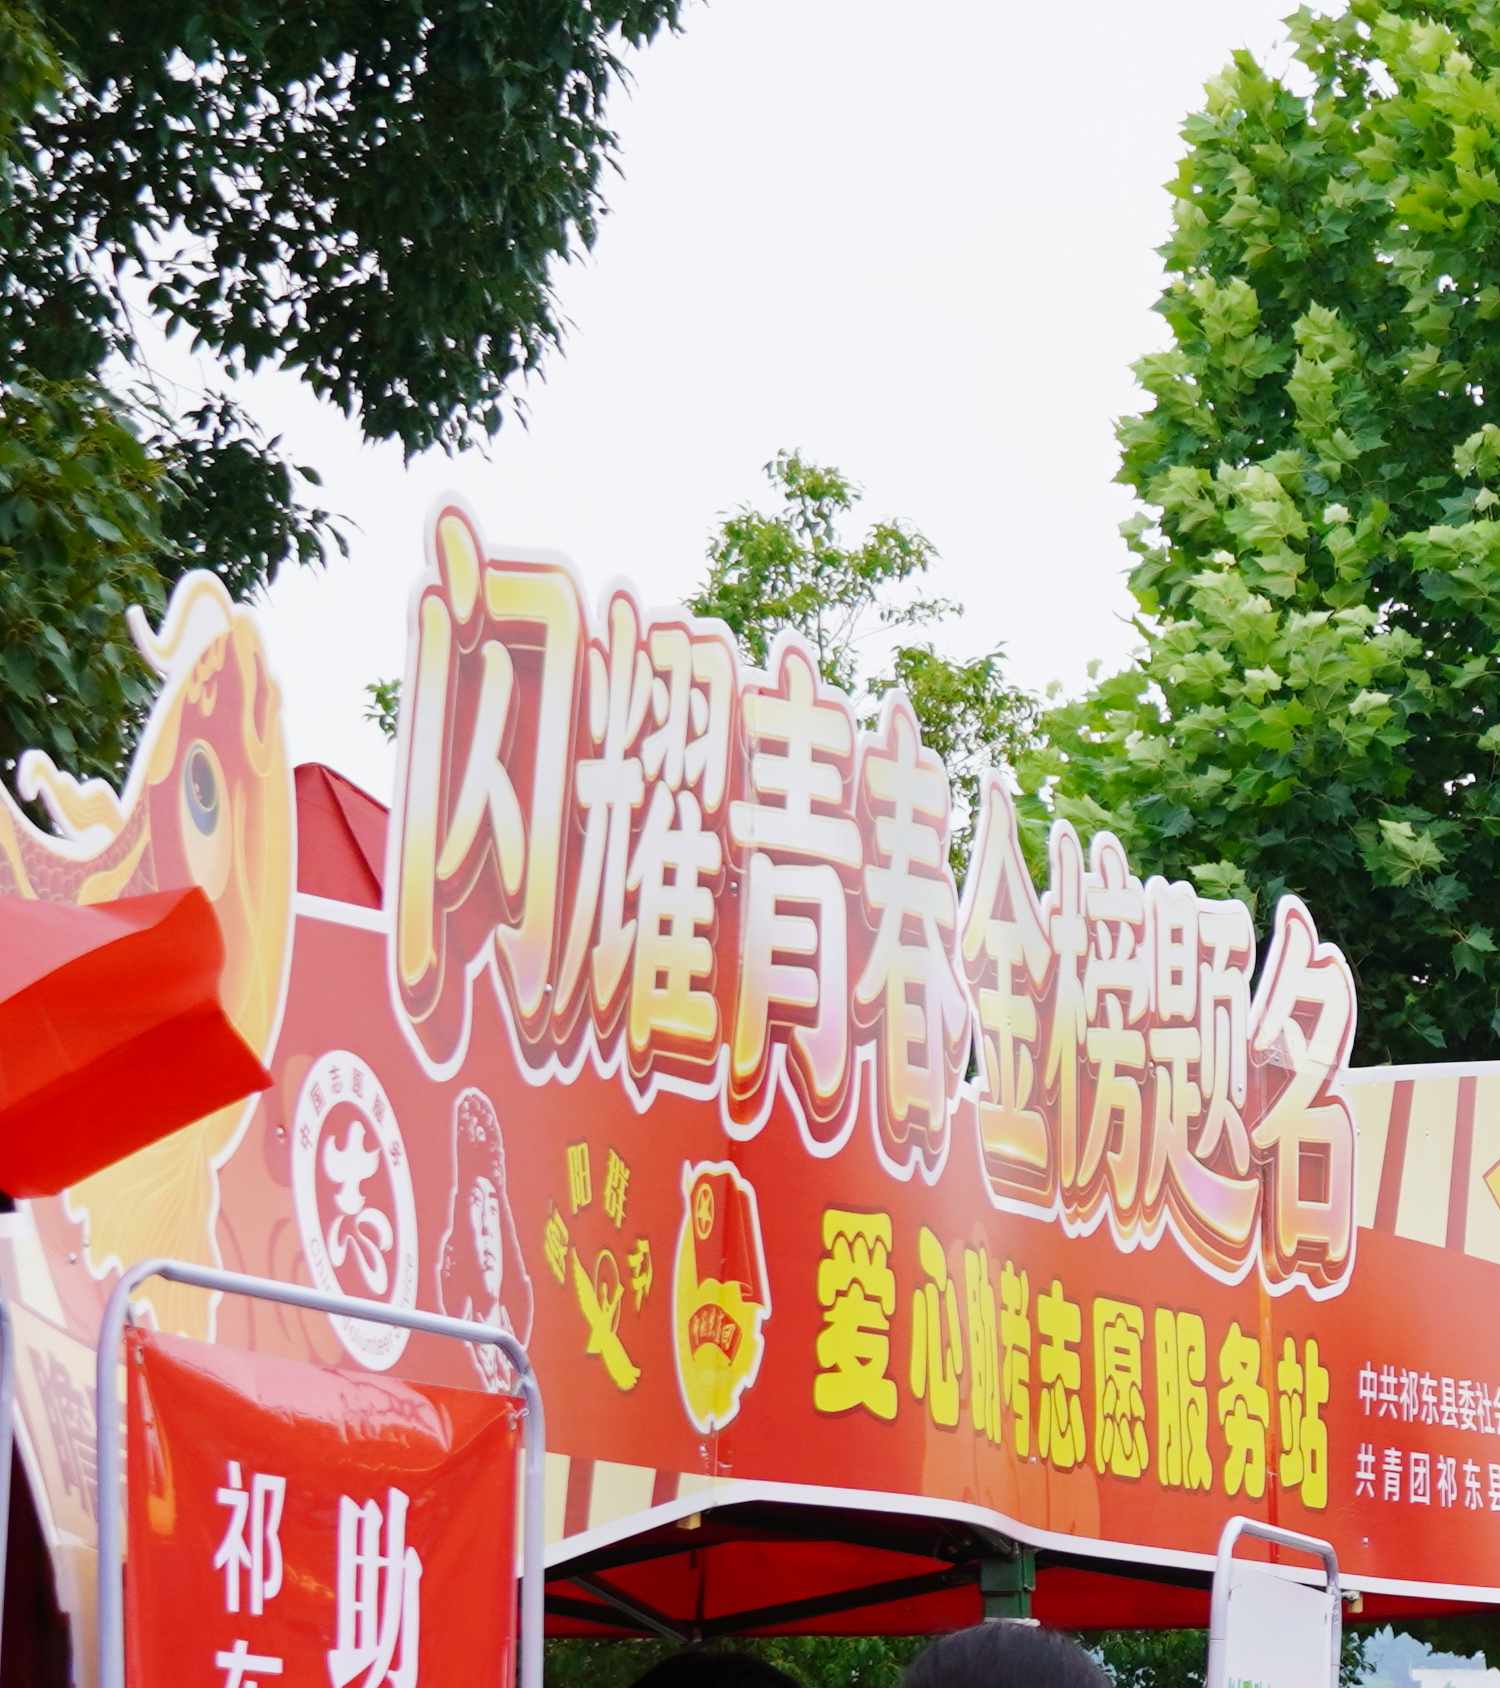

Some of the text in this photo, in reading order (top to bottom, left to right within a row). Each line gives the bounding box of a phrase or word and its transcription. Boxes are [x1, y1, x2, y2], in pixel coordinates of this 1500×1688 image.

[815, 1209, 1331, 1510] 爱心助考志愿服务站
